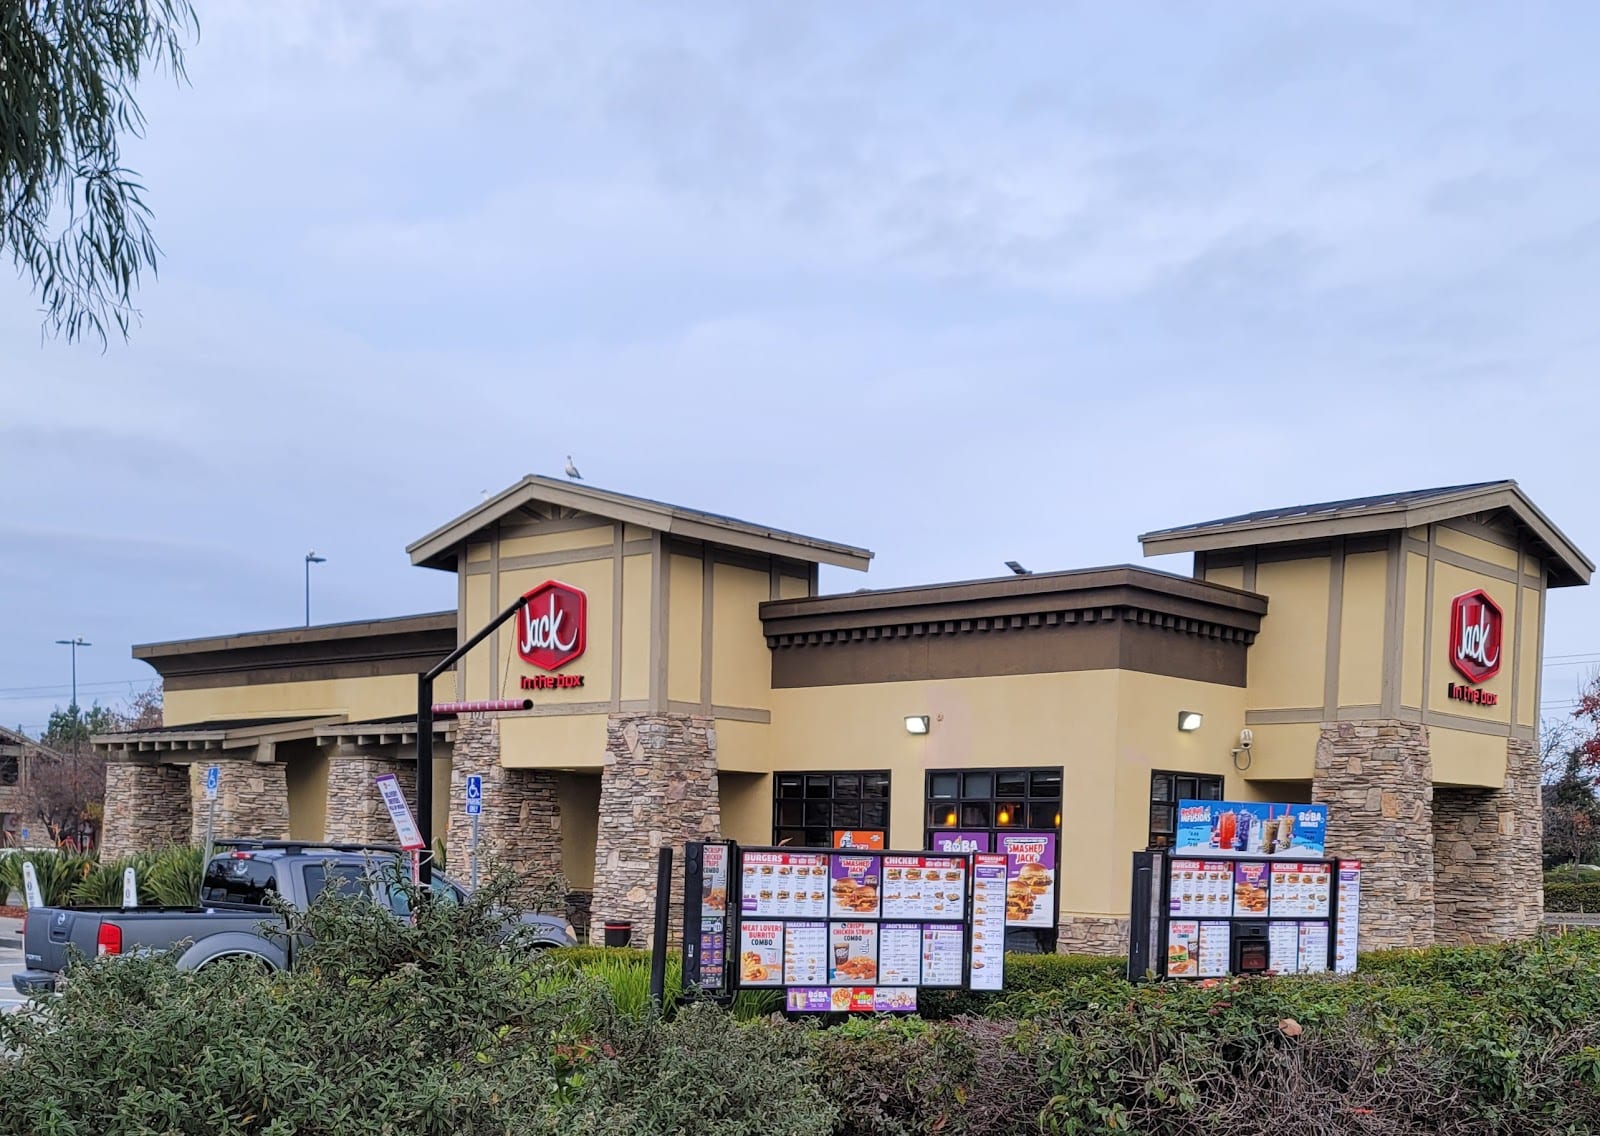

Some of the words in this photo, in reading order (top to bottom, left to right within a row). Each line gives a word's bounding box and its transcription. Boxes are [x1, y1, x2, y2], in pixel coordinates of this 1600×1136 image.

[521, 593, 578, 653] Jack
[1457, 604, 1500, 667] Jack
[533, 675, 554, 689] the
[558, 673, 582, 688] box
[1464, 685, 1479, 703] the
[1481, 688, 1498, 705] box
[1009, 844, 1043, 853] SMASHED
[743, 853, 783, 862] BURGERS
[884, 856, 919, 864] CHICKEN
[1017, 853, 1034, 863] JACK
